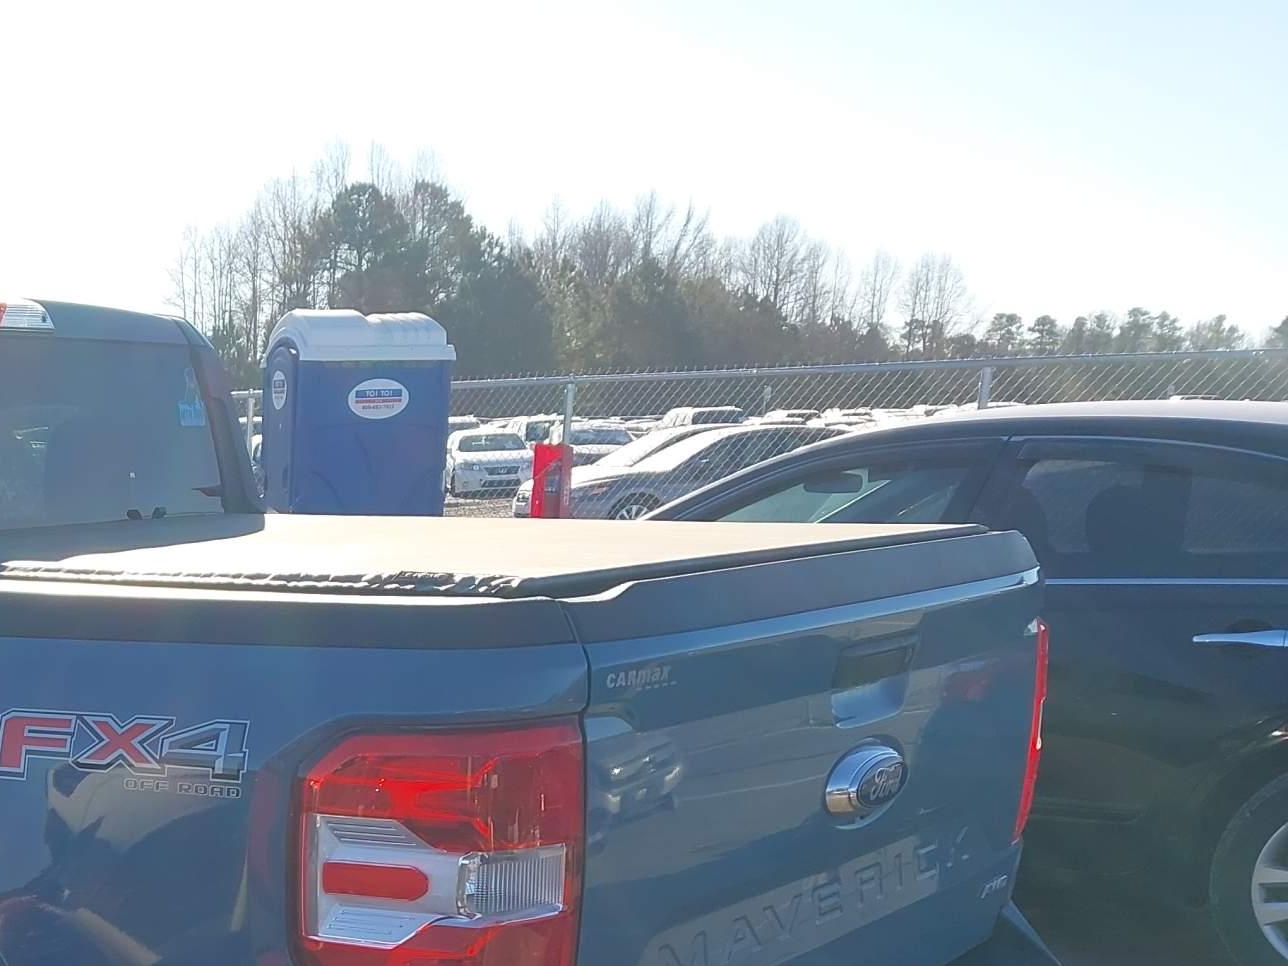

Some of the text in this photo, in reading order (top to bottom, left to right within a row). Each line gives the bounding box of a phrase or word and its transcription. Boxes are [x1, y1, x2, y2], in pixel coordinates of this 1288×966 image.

[123, 777, 241, 799] OFF ROAD
[870, 763, 903, 801] Ford
